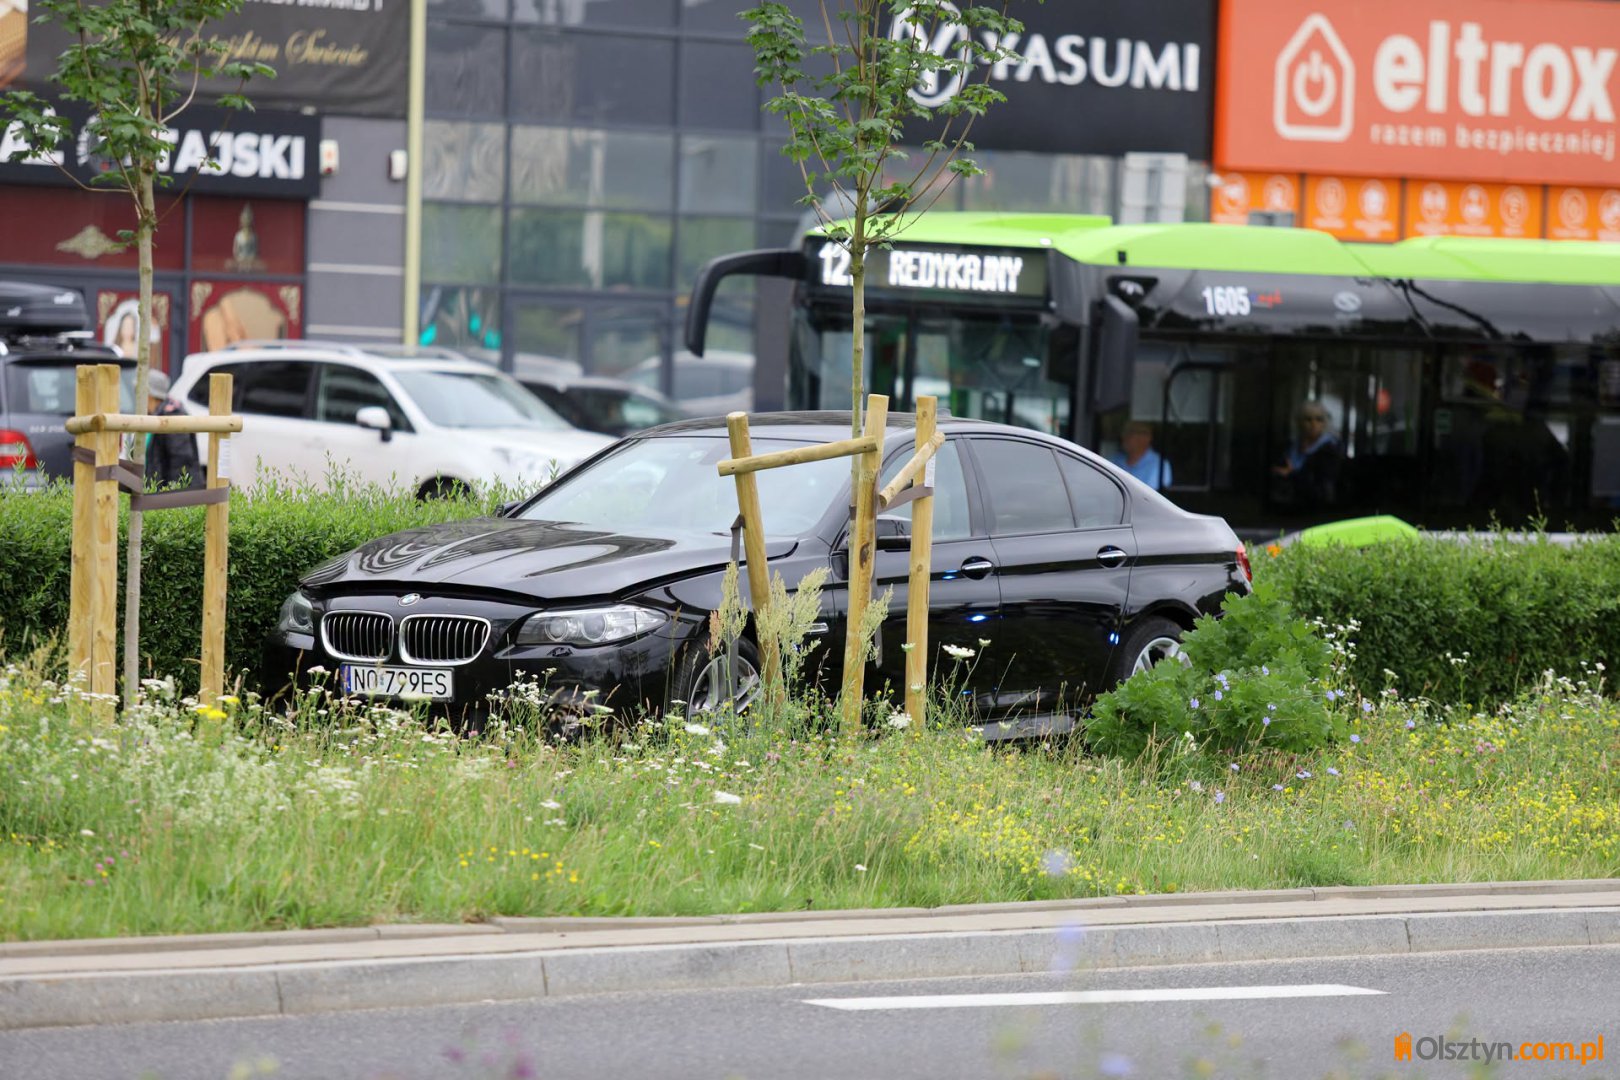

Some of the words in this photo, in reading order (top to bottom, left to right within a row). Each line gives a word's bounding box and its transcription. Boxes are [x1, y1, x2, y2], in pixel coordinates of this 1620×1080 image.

[980, 31, 1200, 92] YASUMI
[1373, 20, 1617, 122] eltrox
[151, 129, 306, 180] TAJSKI
[1370, 123, 1446, 147] razem
[1455, 122, 1616, 162] bezpieczniej
[819, 237, 869, 286] 12
[888, 250, 1023, 293] REDYKAJNY
[1202, 285, 1250, 316] 1605
